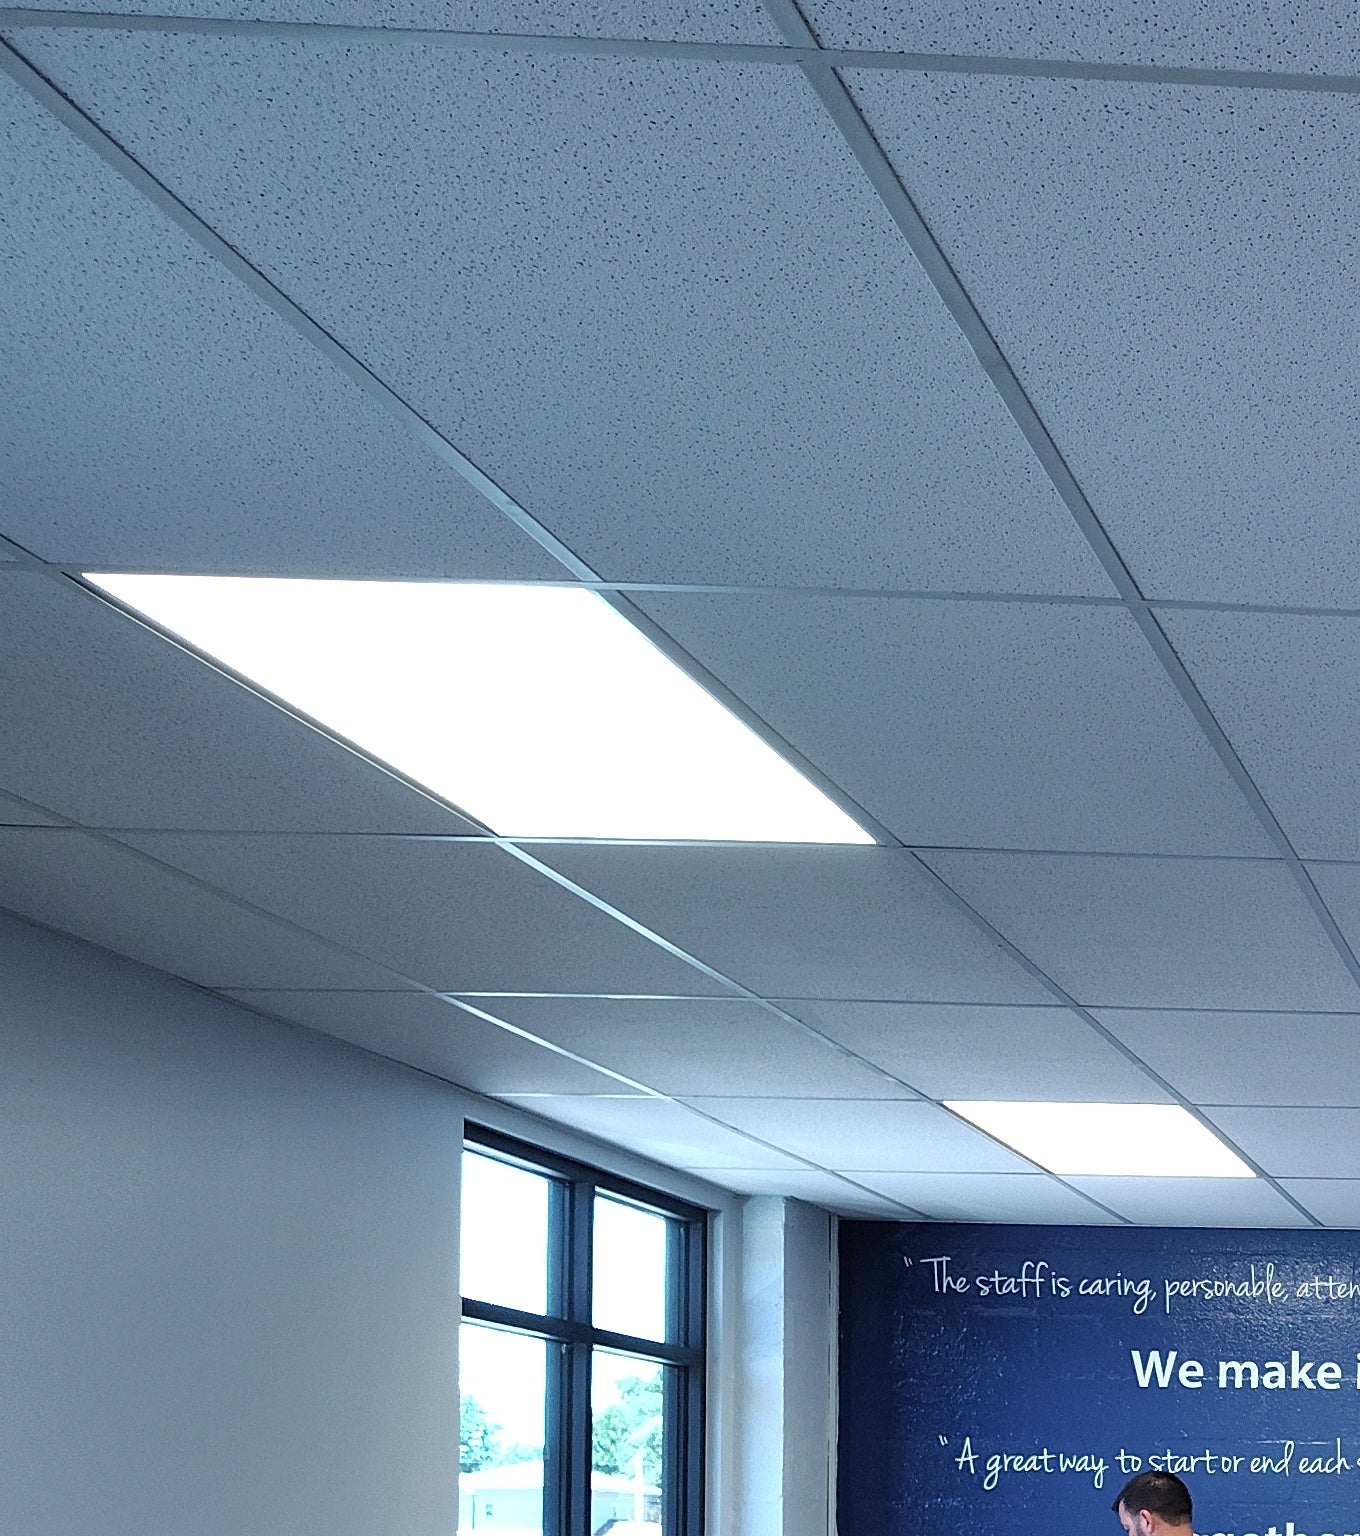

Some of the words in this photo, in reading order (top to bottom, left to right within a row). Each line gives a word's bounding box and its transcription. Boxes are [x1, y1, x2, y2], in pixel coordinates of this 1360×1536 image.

[976, 1261, 1048, 1297] staff
[1051, 1271, 1073, 1297] is
[1079, 1271, 1157, 1314] caring,
[1165, 1263, 1289, 1314] personable,
[1130, 1350, 1203, 1389] We
[1218, 1351, 1341, 1390] make
[983, 1448, 1054, 1491] great
[1059, 1454, 1109, 1489] way
[1115, 1449, 1142, 1473] to
[1148, 1449, 1219, 1474] start
[1221, 1455, 1246, 1473] or
[1250, 1440, 1294, 1477] end
[1299, 1437, 1351, 1475] each
